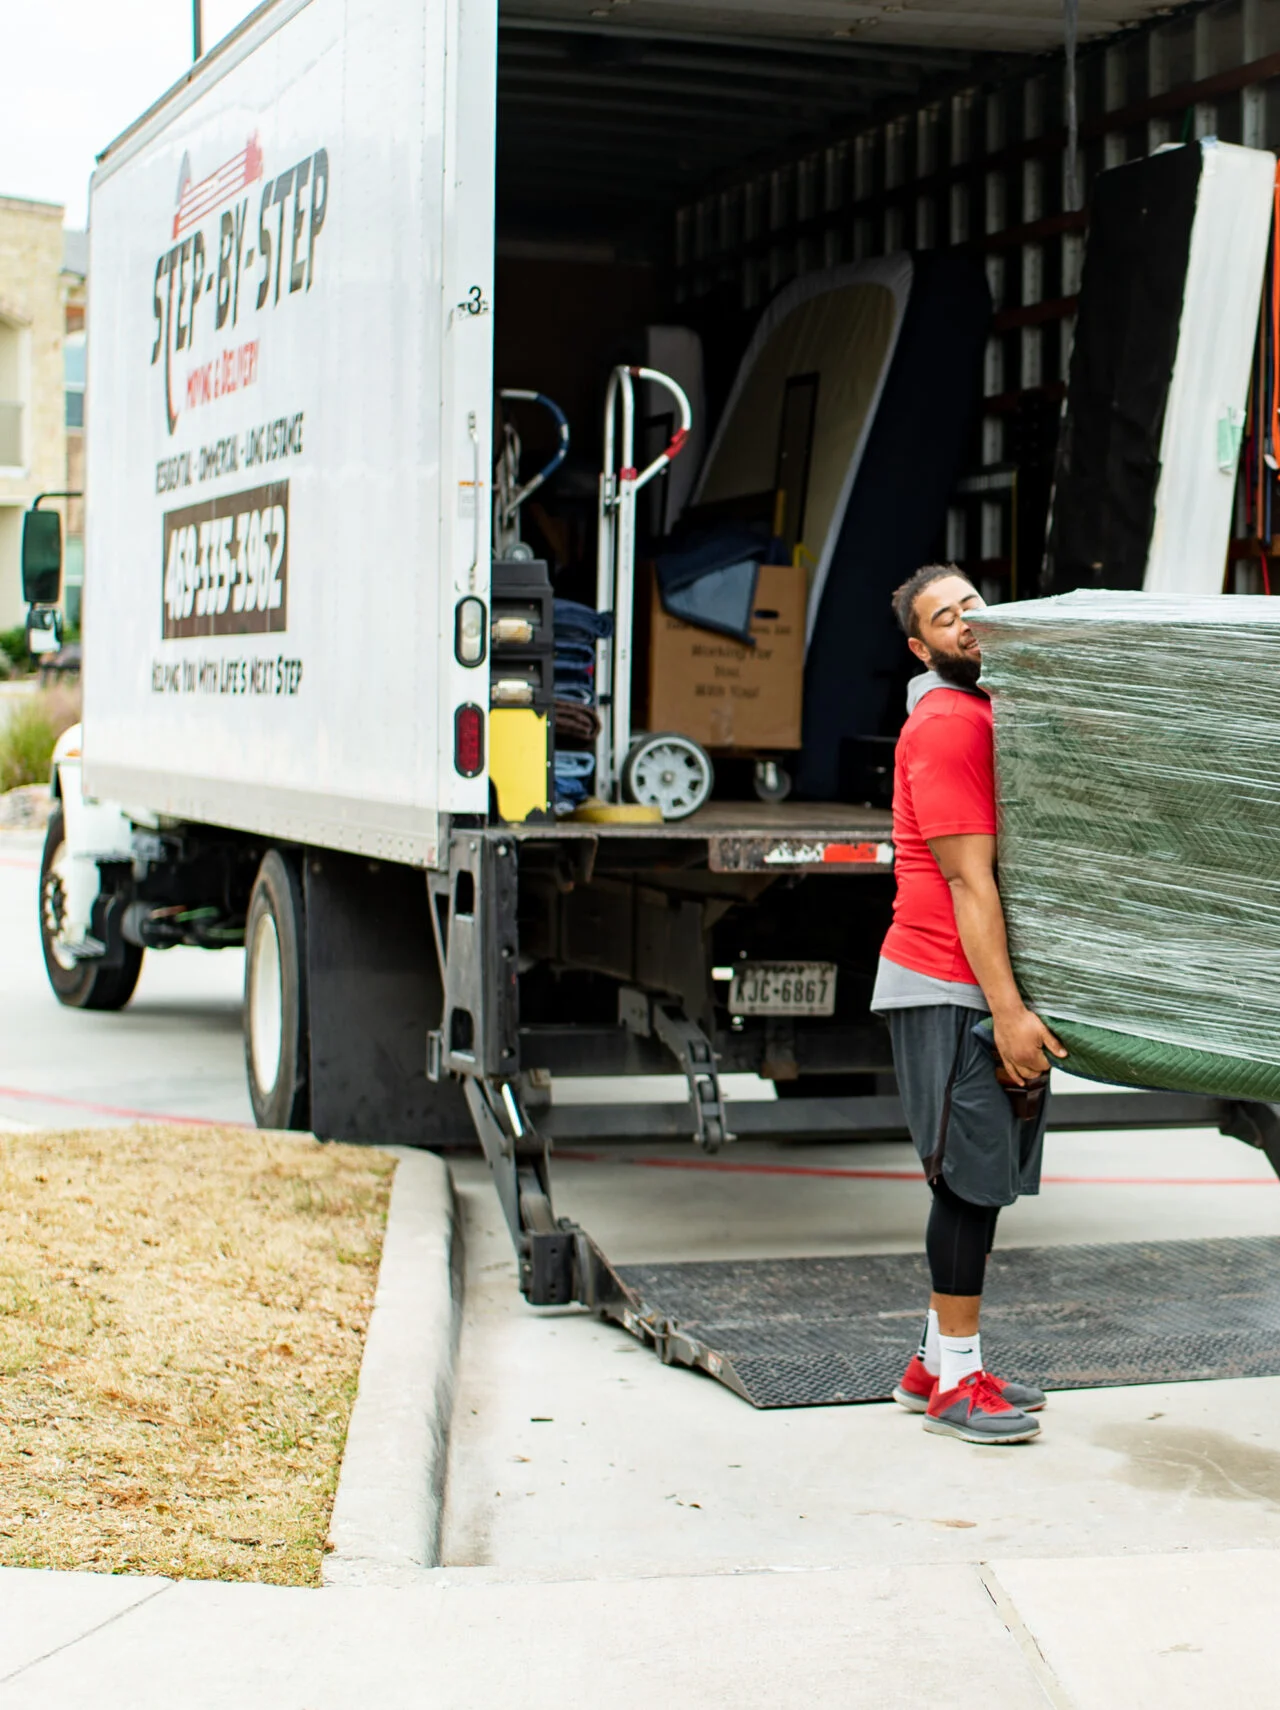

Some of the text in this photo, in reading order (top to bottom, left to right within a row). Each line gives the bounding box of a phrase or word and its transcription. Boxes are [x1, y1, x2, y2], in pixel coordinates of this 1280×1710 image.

[151, 147, 329, 436] STEP-BY-STEP
[468, 285, 482, 315] 3
[221, 338, 260, 395] DELIVERY
[275, 653, 304, 695] STEP
